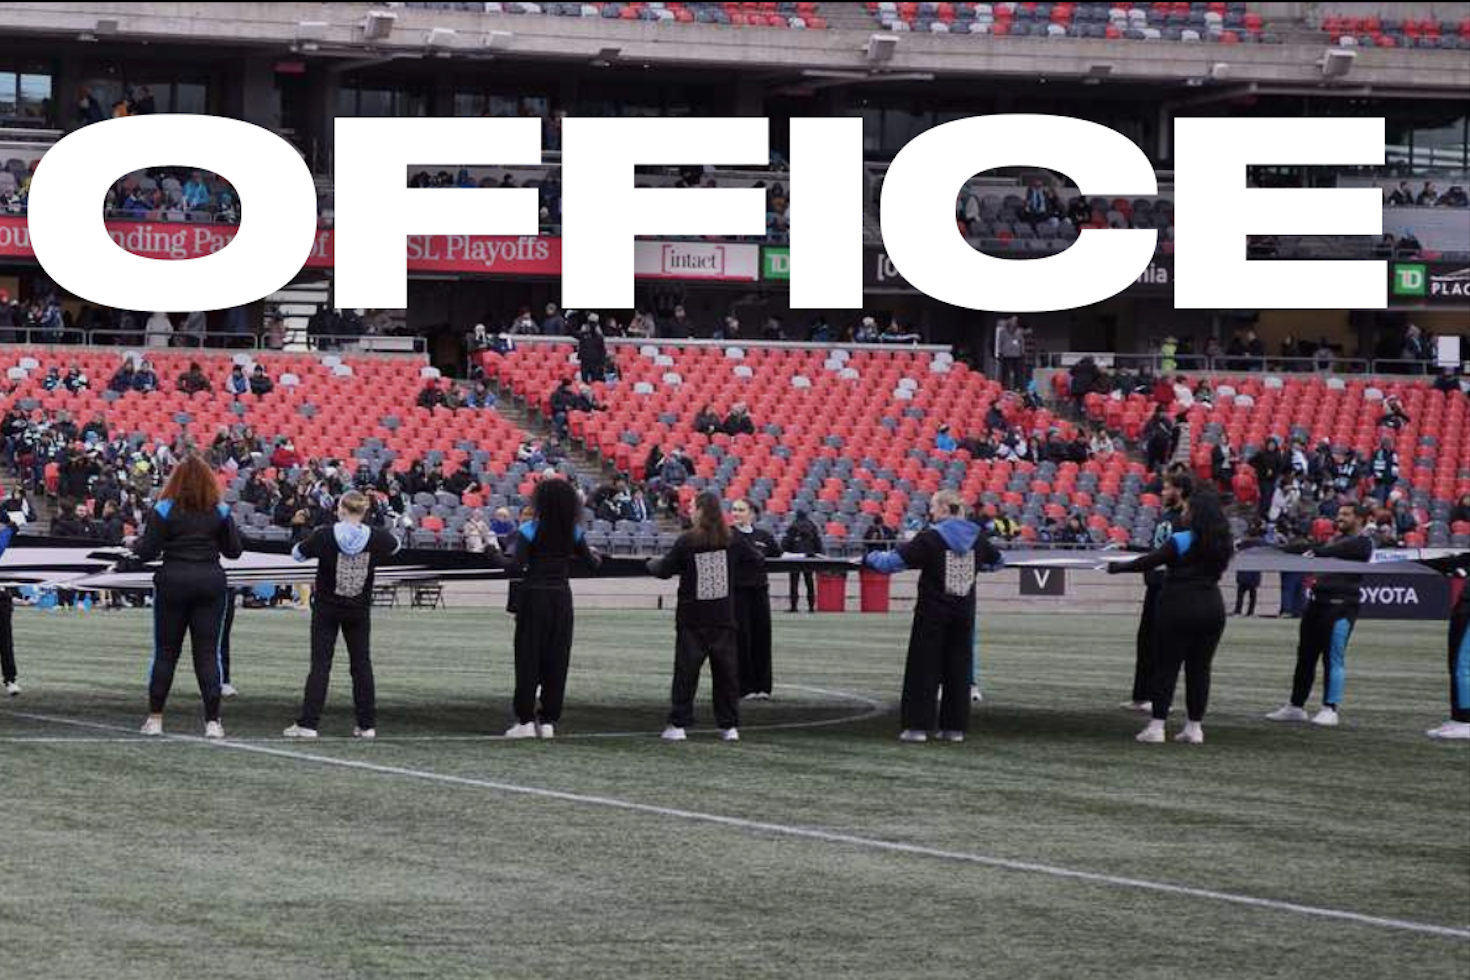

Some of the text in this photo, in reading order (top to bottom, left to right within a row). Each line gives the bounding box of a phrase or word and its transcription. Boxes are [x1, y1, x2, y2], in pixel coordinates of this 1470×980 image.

[446, 235, 549, 266] Playoffs
[1396, 269, 1422, 289] TD
[1033, 569, 1050, 589] V
[1358, 586, 1419, 605] OYOTA
